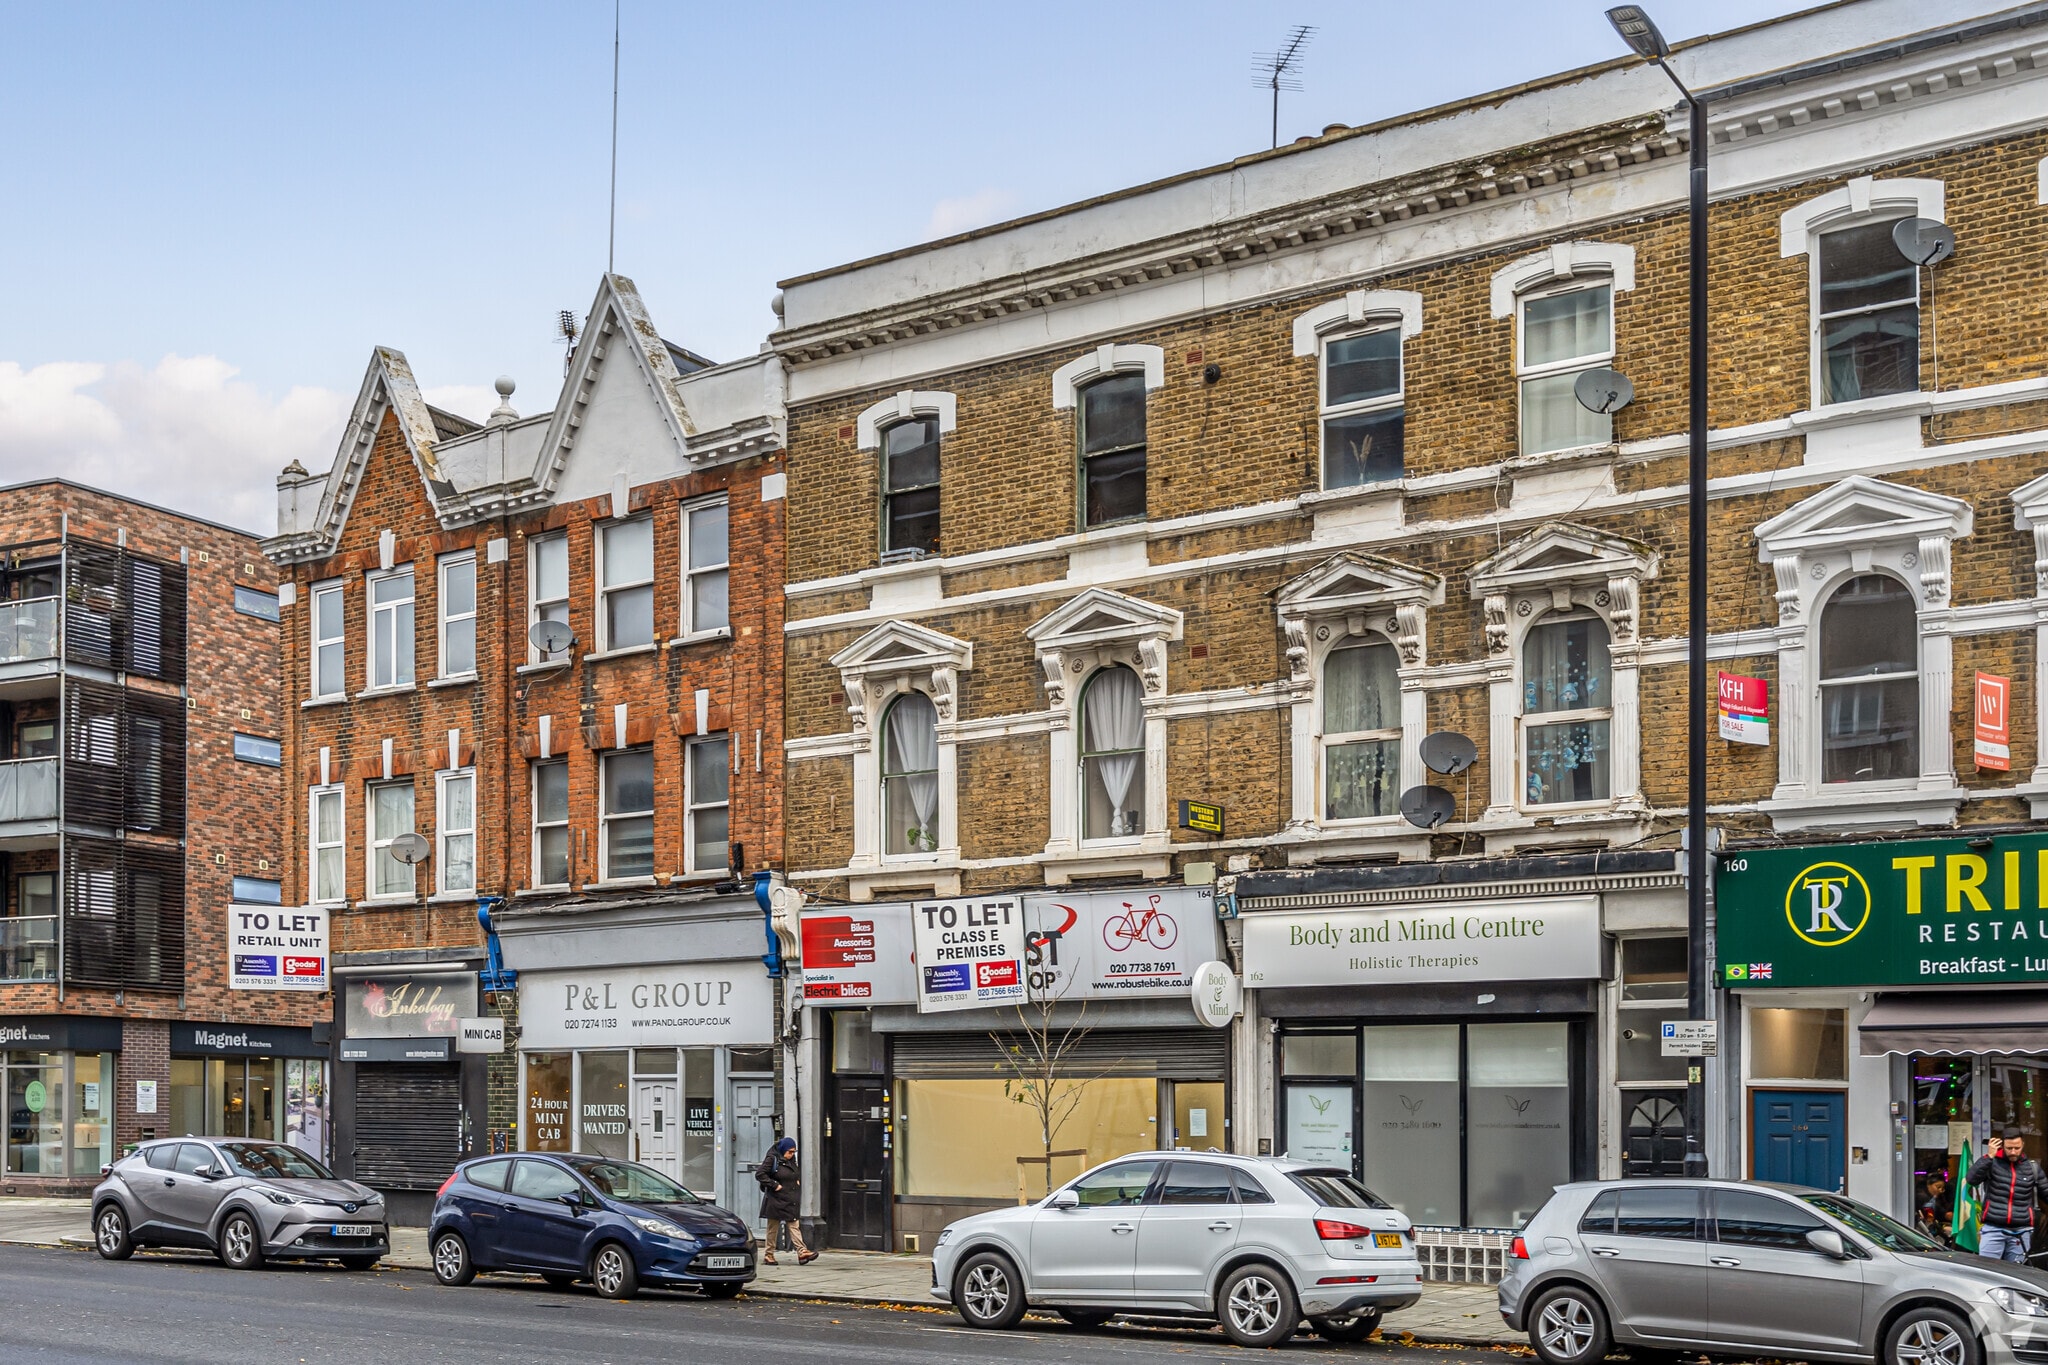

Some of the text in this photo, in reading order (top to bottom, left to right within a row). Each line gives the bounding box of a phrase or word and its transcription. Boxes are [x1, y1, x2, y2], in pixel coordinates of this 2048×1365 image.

[1720, 678, 1743, 701] KFH
[1731, 722, 1744, 731] SALE
[1724, 859, 1748, 872] 160
[1892, 849, 2048, 914] TRI
[1197, 890, 1212, 898] 164
[922, 902, 1014, 929] TO LET
[238, 913, 320, 932] TO LET
[850, 922, 871, 932] Bikes
[942, 930, 999, 944] CLASS E
[1289, 916, 1545, 948] Body and Mind Centre
[238, 936, 322, 948] RETAIL UNIT
[834, 938, 872, 948] Acessories
[842, 952, 872, 961] Services
[936, 944, 1006, 960] PREMISES
[1110, 962, 1176, 973] 020 7738 7691
[1349, 954, 1478, 970] Holistic Therapies
[1920, 956, 2006, 975] Breakfast
[2024, 956, 2048, 972] Lu
[1208, 973, 1228, 986] Body
[1250, 972, 1264, 981] 162
[564, 981, 732, 1010] P&L GROUP
[805, 984, 869, 996] Electric bikes
[1007, 986, 1022, 994] 6455
[1214, 987, 1223, 1001] &
[371, 982, 455, 1021] Inkology
[1208, 1003, 1229, 1016] Mind
[564, 1019, 617, 1029] 020 7274 1133
[632, 1017, 731, 1027] WWW.PANDLGROUP.CO.UK
[0, 1025, 27, 1043] gnet
[464, 1029, 502, 1040] MINI CAB
[1665, 1026, 1673, 1036] P
[195, 1030, 248, 1048] Magnet
[531, 1098, 568, 1110] 24 HOUR
[584, 1104, 626, 1116] DRIVERS
[535, 1113, 564, 1124] MINI
[690, 1109, 709, 1119] LIVE
[584, 1122, 625, 1134] WANTED
[686, 1120, 712, 1128] VEHICLE
[538, 1128, 560, 1139] CAB
